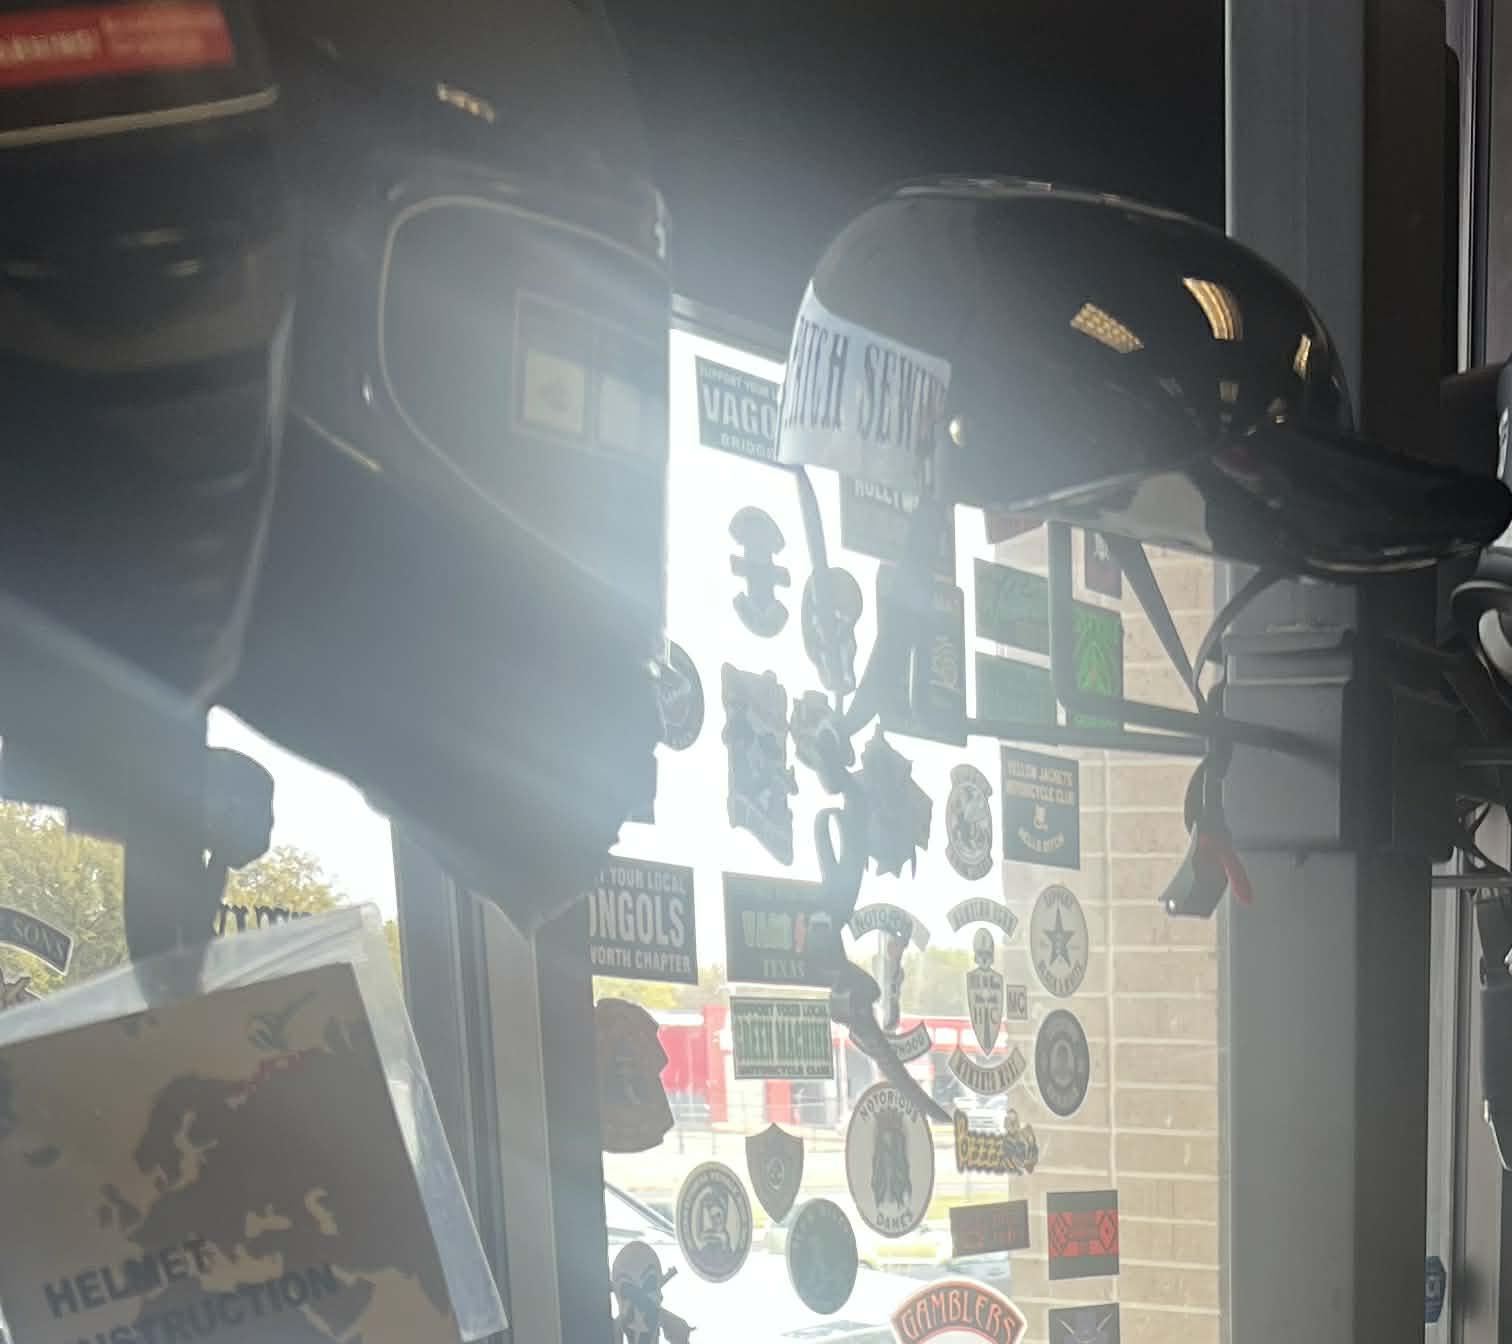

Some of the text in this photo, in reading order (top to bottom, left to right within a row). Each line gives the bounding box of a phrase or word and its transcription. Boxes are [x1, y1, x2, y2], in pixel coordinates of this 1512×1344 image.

[702, 382, 777, 441] VAGO
[611, 865, 687, 895] YOUR LOCAL
[588, 887, 687, 949] NGOLS
[12, 917, 65, 955] SONS
[635, 950, 691, 974] CHAPTER
[734, 1003, 829, 1018] SUPPORT YOUR LOCAL
[737, 1065, 830, 1077] MOTORCYCLE CLUB
[44, 1239, 214, 1320] HELMET
